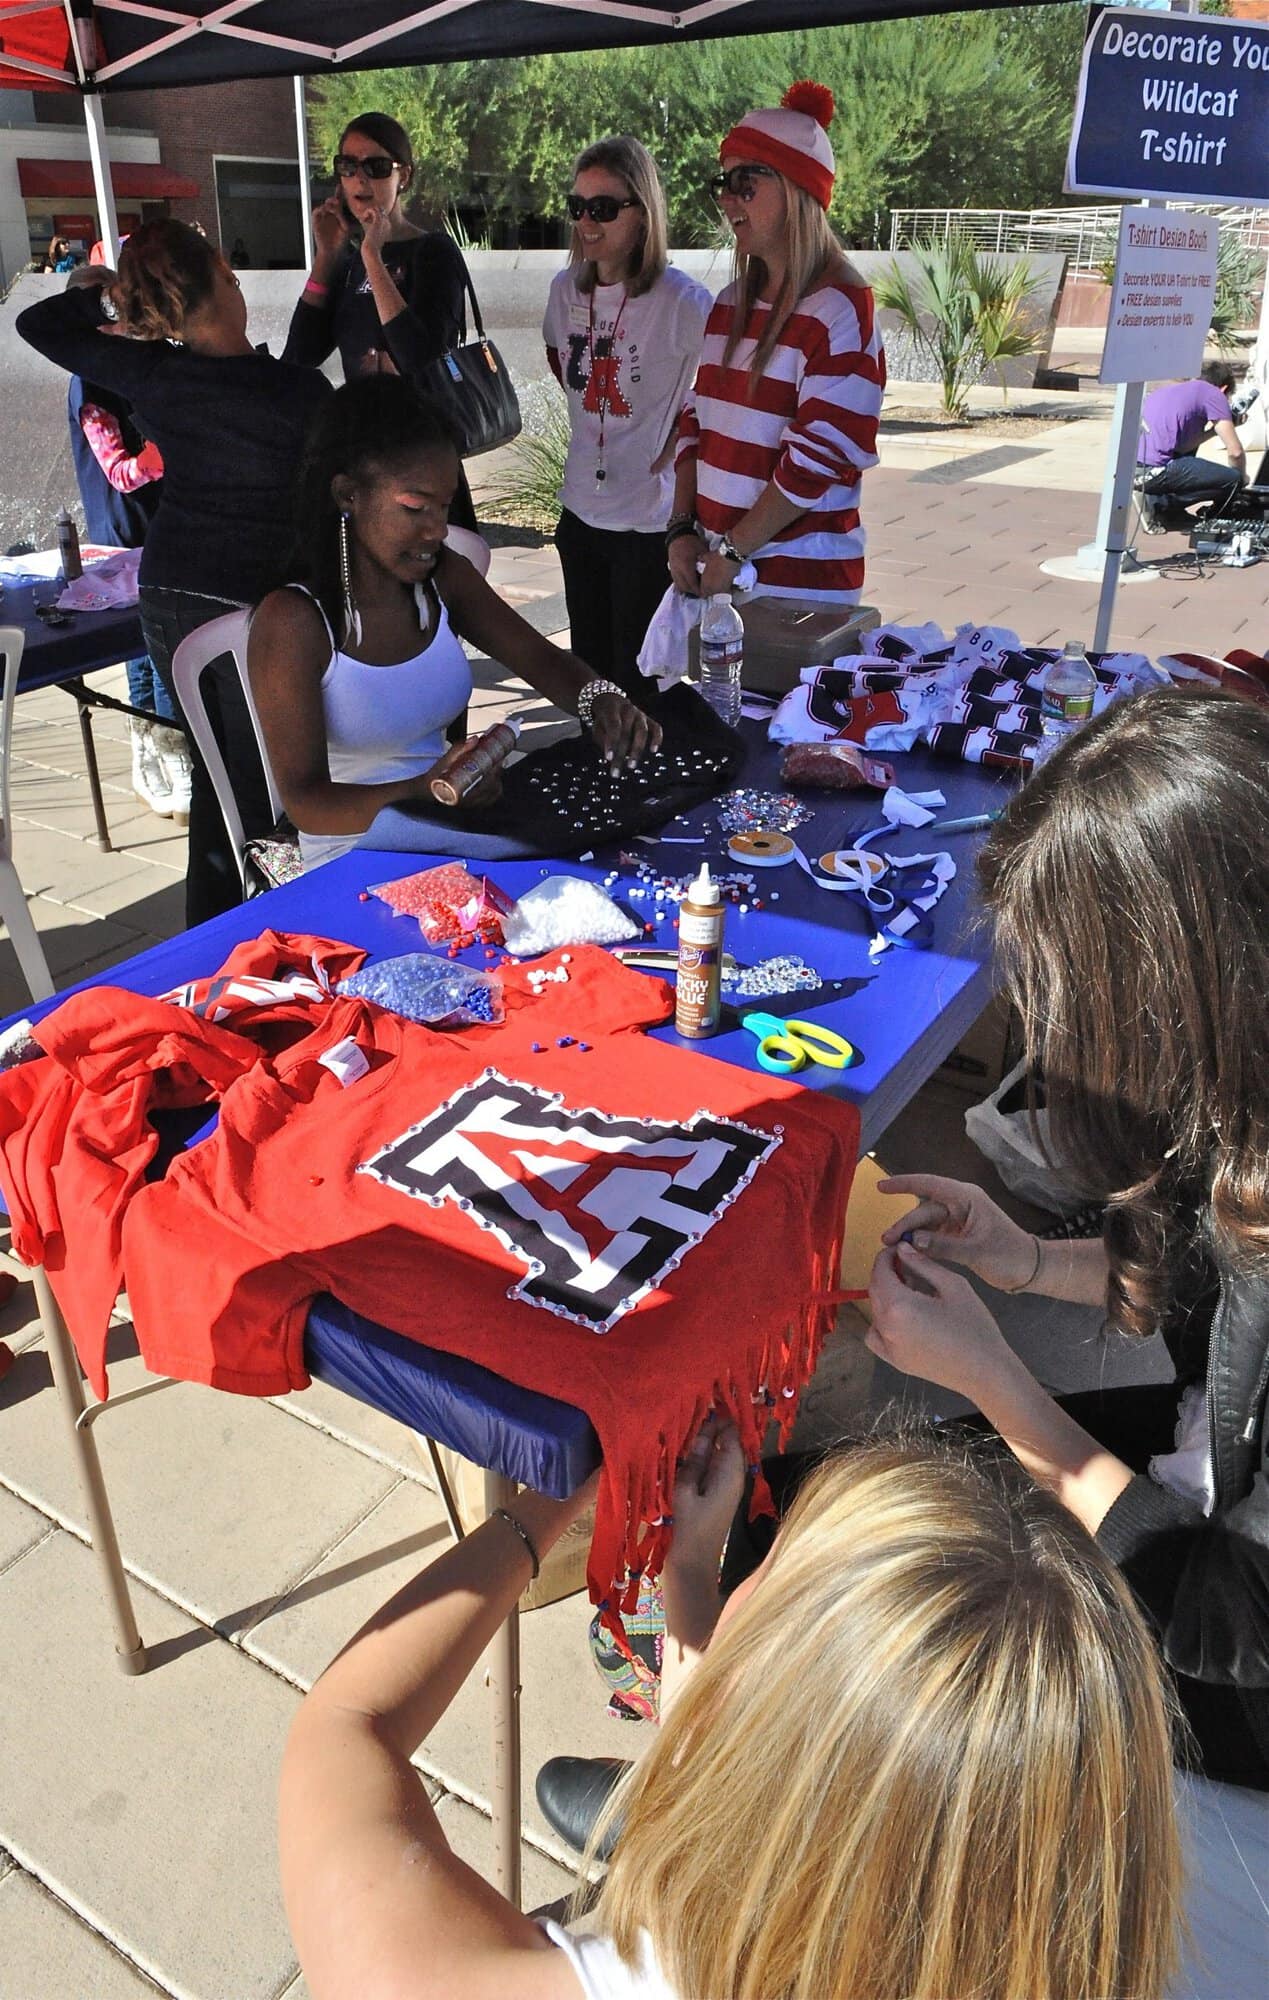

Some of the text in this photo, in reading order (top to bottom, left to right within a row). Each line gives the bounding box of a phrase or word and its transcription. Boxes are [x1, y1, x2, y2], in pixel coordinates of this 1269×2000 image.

[1102, 23, 1222, 66] Decorate
[1142, 78, 1239, 117] Wildcat
[1140, 129, 1227, 166] T-shirt
[1128, 223, 1156, 245] T-shirt
[1159, 226, 1187, 247] Design
[1123, 273, 1150, 287] Decorate
[1150, 274, 1168, 287] YOUR
[1126, 293, 1143, 306] FREE
[1143, 294, 1161, 307] design
[1121, 314, 1143, 327] Design
[1143, 315, 1165, 327] experts
[628, 344, 641, 383] BOLD
[677, 979, 709, 993] ACKY
